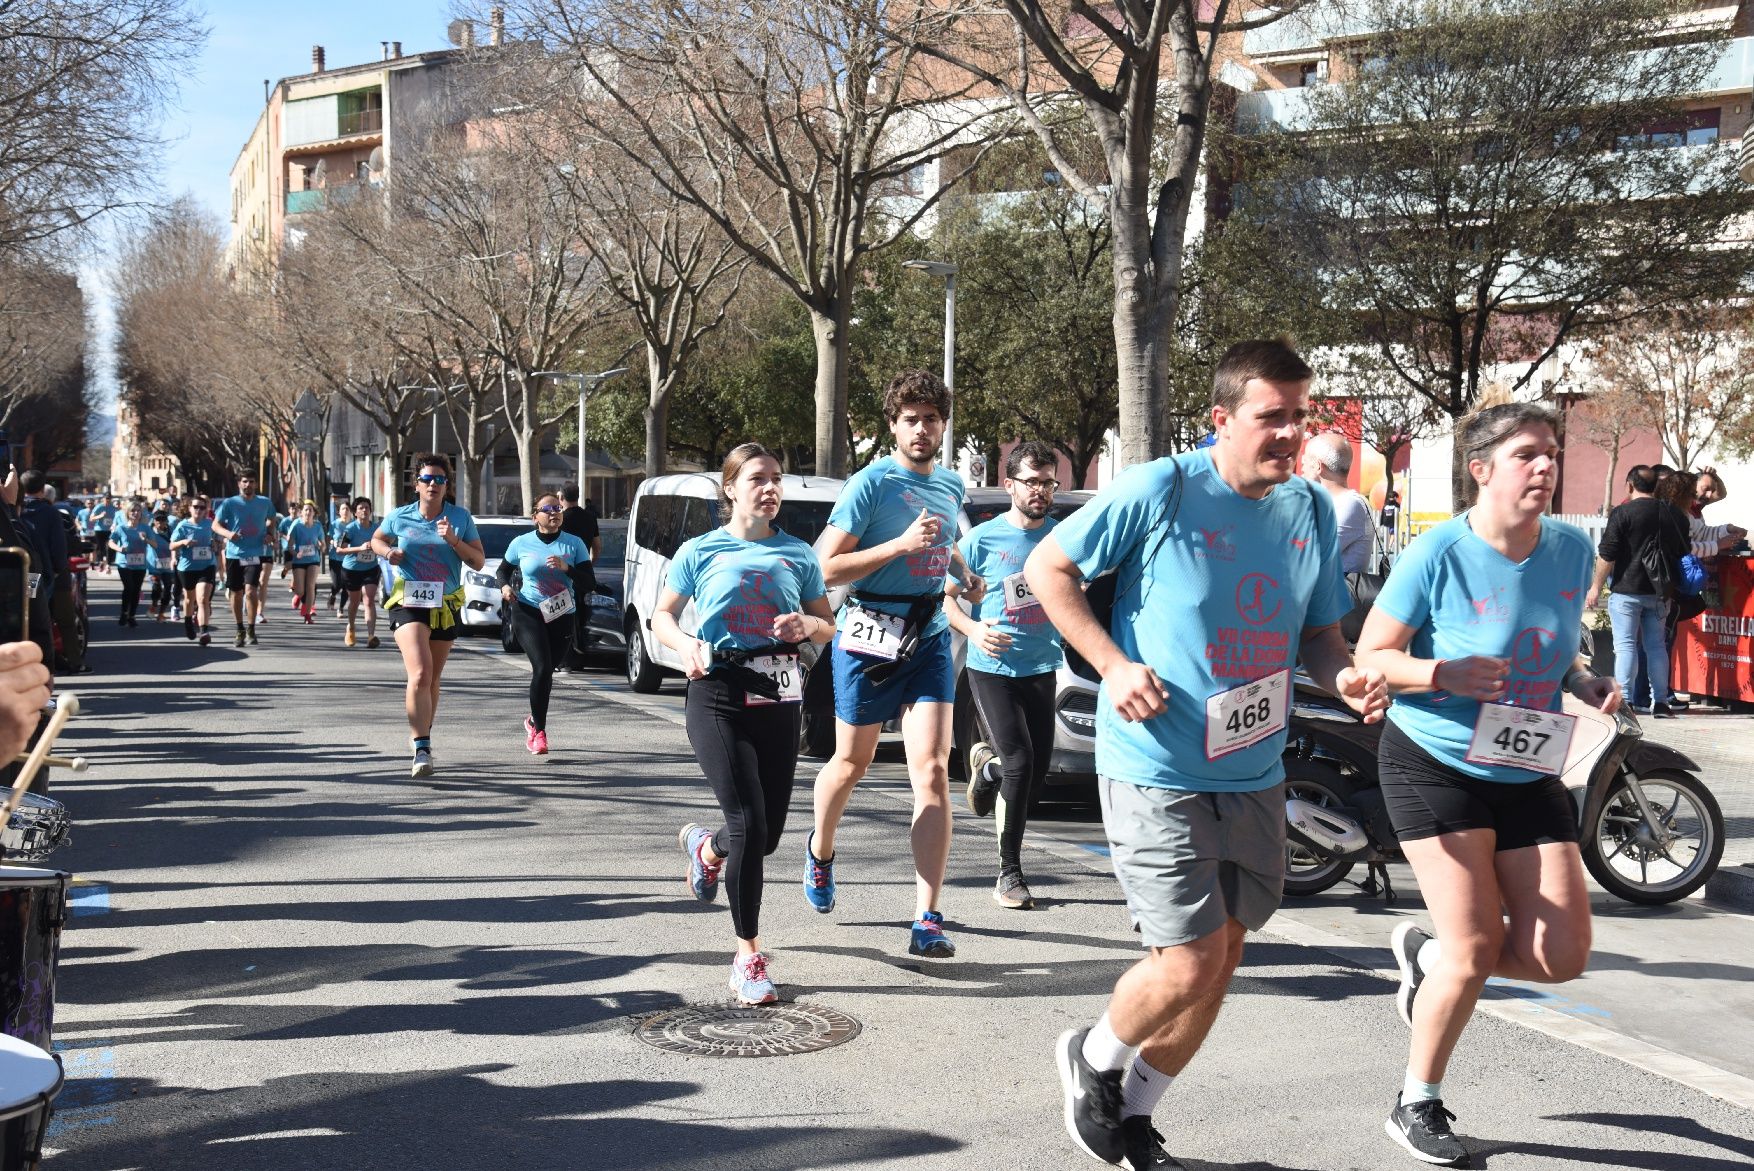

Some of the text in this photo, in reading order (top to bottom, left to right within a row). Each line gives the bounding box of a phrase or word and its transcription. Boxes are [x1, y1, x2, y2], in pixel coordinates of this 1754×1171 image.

[411, 589, 435, 600] 443
[549, 599, 566, 614] 444
[850, 621, 887, 644] 211
[1702, 613, 1754, 637] ESTRELLA
[1217, 626, 1289, 648] VII CURSA
[1718, 634, 1738, 646] DAMM
[1206, 643, 1229, 660] DE
[1231, 646, 1250, 663] LA
[1226, 697, 1270, 733] 468
[1493, 726, 1552, 756] 467
